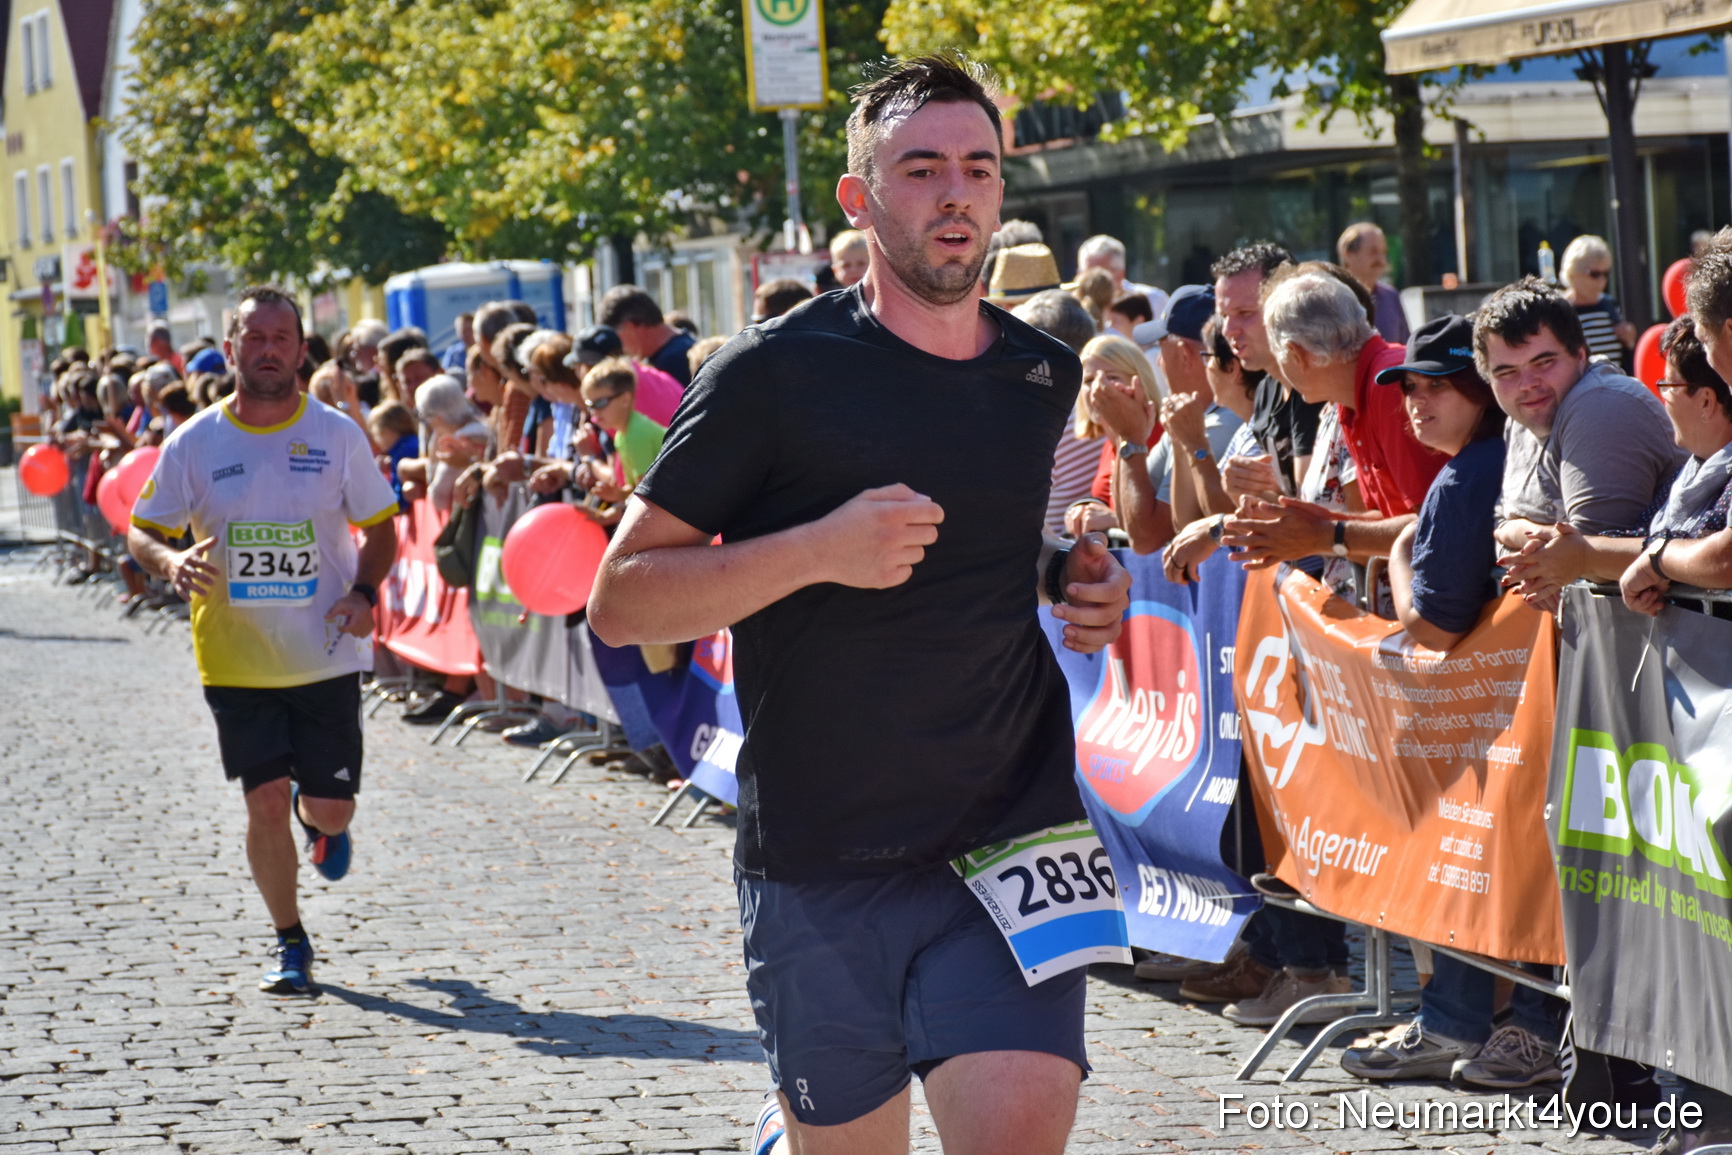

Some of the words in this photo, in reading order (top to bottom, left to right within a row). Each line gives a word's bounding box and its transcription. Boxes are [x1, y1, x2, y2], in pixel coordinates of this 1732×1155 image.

[1025, 373, 1053, 387] adidas
[289, 443, 308, 455] 20
[233, 524, 311, 547] BOCK
[238, 551, 312, 577] 2342
[247, 585, 308, 597] RONALD
[1473, 647, 1529, 669] Partner
[1399, 682, 1458, 710] Konzeption
[1457, 679, 1487, 701] und
[1083, 655, 1197, 775] Hervis
[1219, 712, 1241, 740] ONLI
[1413, 711, 1470, 736] Projekte
[1468, 713, 1494, 729] was
[1088, 753, 1130, 784] SPORTS
[1297, 815, 1389, 877] Agentur
[997, 847, 1117, 917] 2836
[1137, 863, 1171, 917] GET
[1470, 870, 1491, 894] 897
[1555, 855, 1650, 903] inspired
[1654, 872, 1667, 918] by
